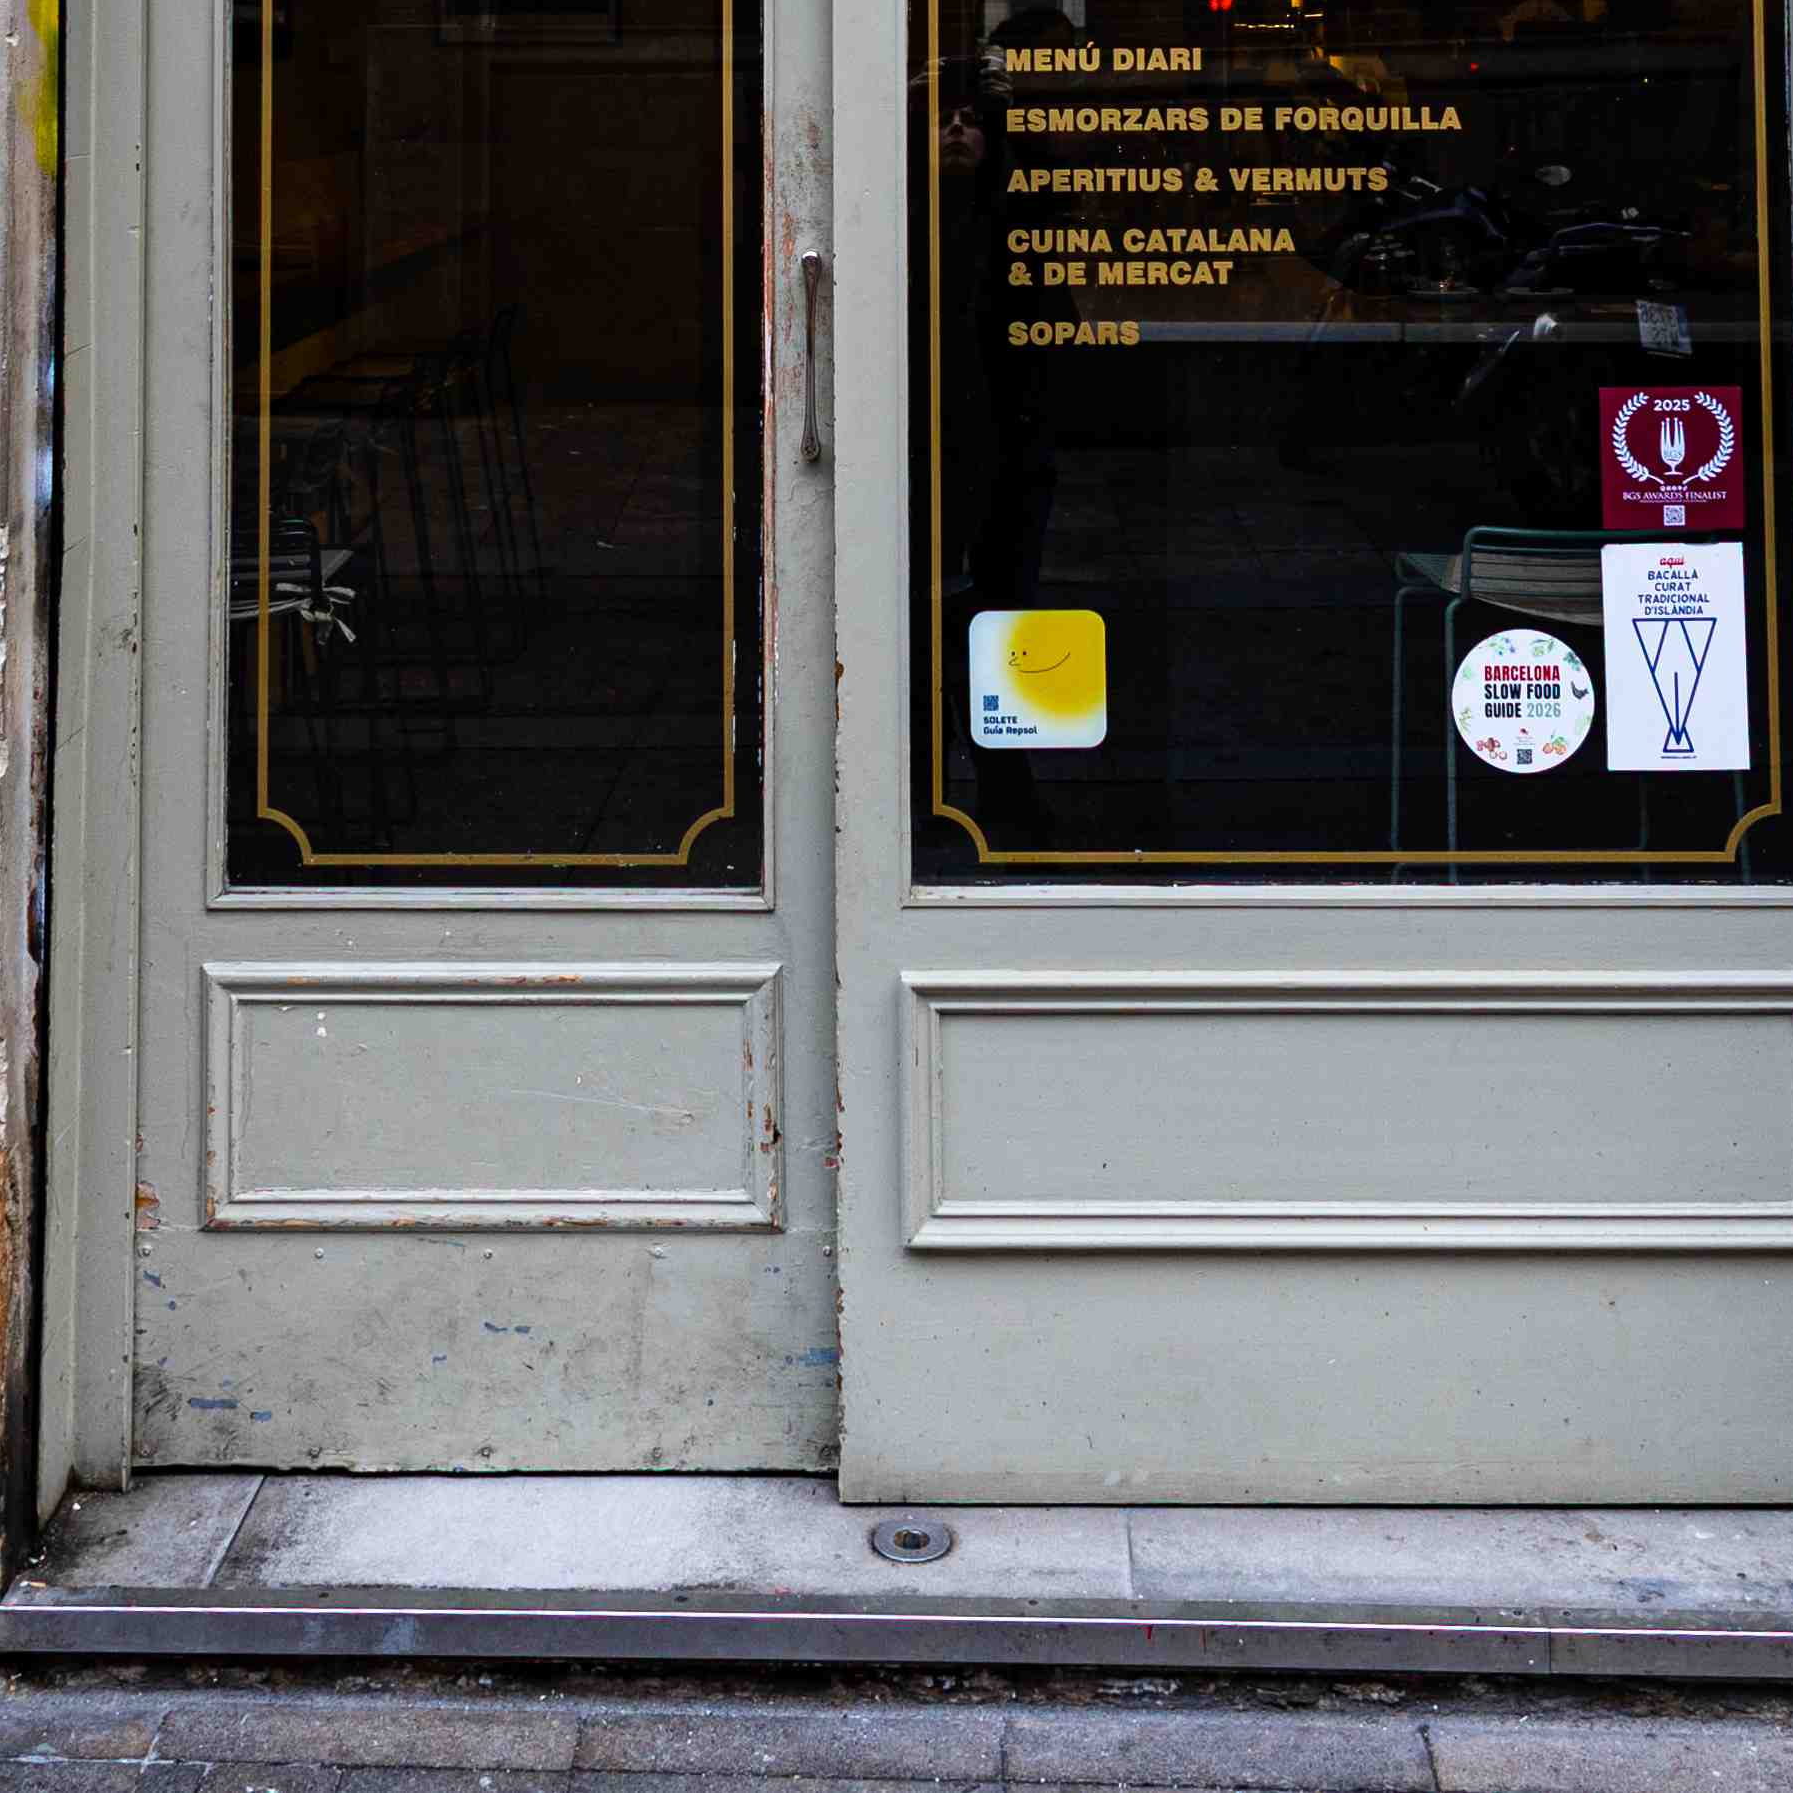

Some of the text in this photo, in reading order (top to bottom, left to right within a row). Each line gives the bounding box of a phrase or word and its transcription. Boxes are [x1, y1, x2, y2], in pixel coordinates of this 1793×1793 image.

[1006, 41, 1202, 73] MENÚ DIARI
[1006, 106, 1462, 132] ESMORZARS DE FORQUILLA
[1007, 166, 1389, 193] APERITIUS & VERMUTS
[1007, 228, 1296, 254] CUINA CATALANA
[1008, 261, 1234, 286] & DE MERCAT
[1008, 320, 1141, 346] SOPARS
[1653, 398, 1691, 412] 2025
[1643, 491, 1684, 500] AWARDS
[1685, 490, 1727, 500] FINALIST
[1654, 582, 1692, 592] CURAT
[1638, 593, 1710, 604] TRADICIONAL
[1484, 664, 1561, 682] BARCELONA
[1484, 683, 1561, 700] SLOW FOOD
[1484, 702, 1562, 719] GUIDE 2026
[983, 715, 1018, 725] SOLETE
[1005, 725, 1039, 736] Repsol
